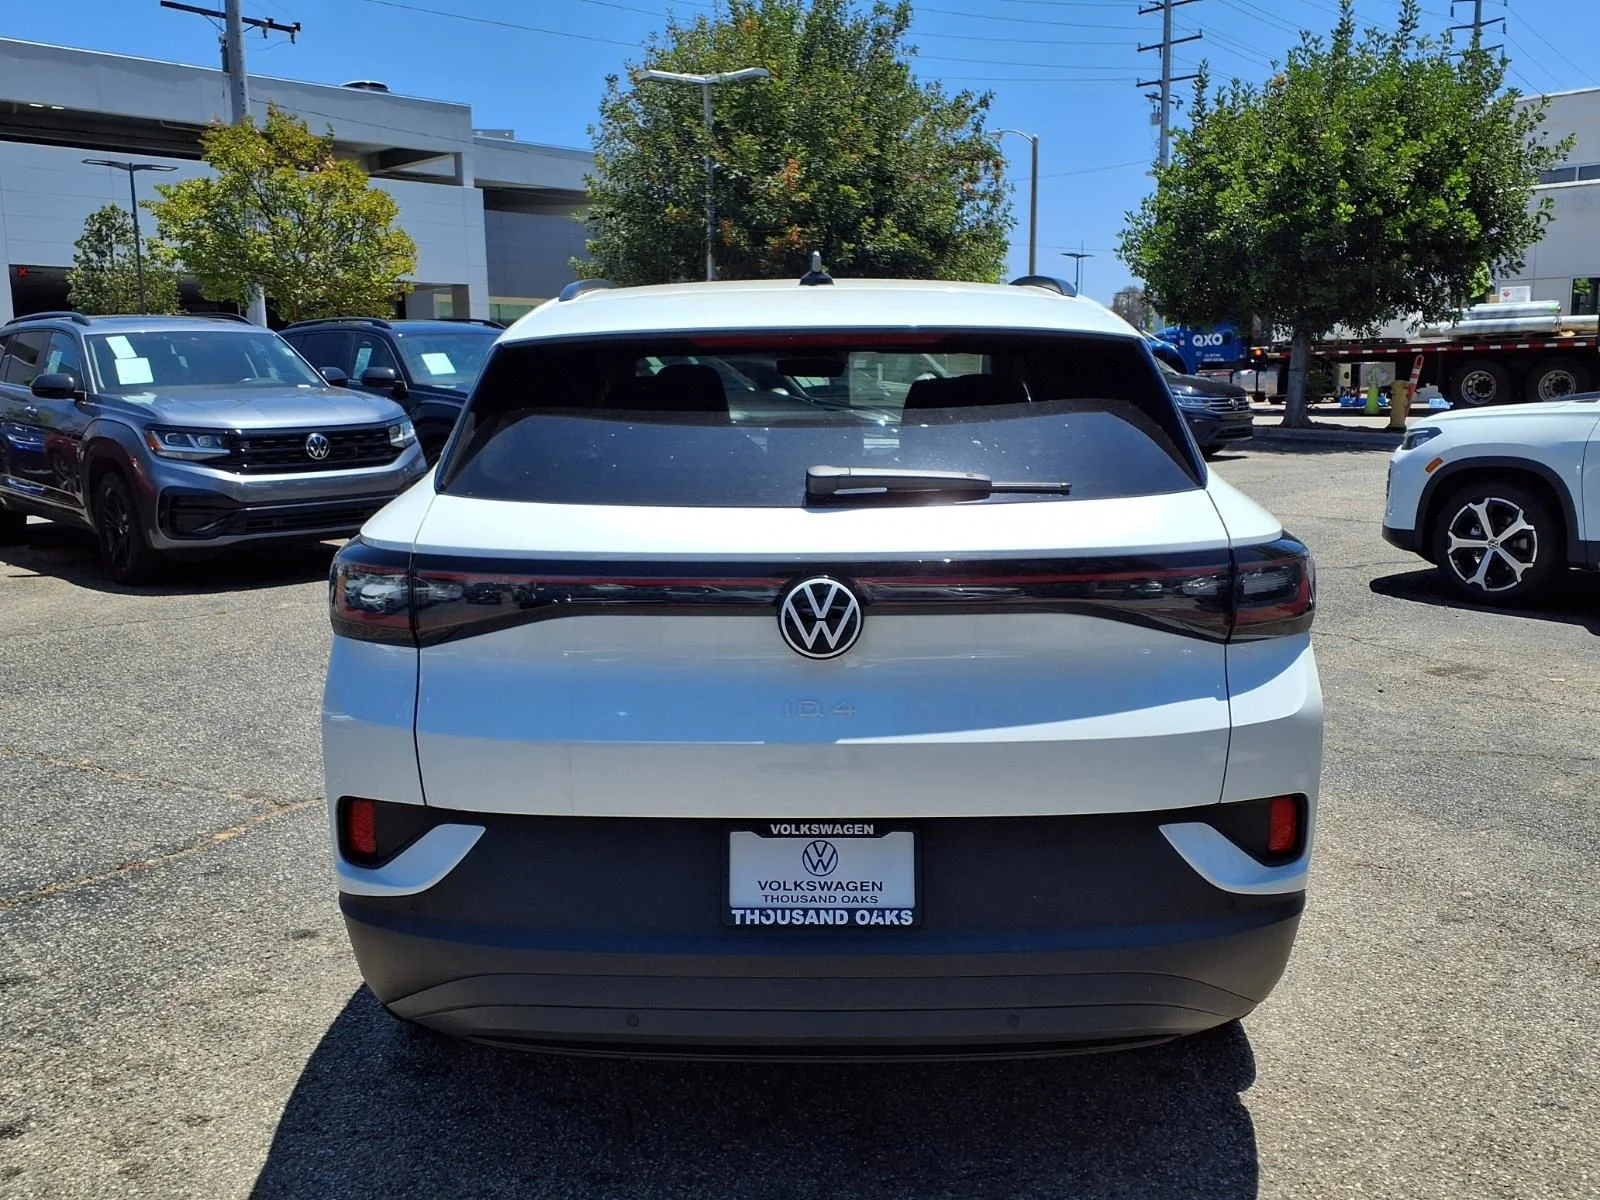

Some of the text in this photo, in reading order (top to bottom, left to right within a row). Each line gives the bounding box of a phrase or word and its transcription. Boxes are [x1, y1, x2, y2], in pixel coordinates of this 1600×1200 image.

[1192, 333, 1223, 347] QXO
[783, 699, 857, 717] ID.4
[770, 824, 874, 835] VOLKSWAGEN
[758, 880, 883, 892] VOLKSWAGEN
[762, 894, 878, 904] THOUSAND OAKS
[731, 910, 913, 925] THOUSAND OAKS
